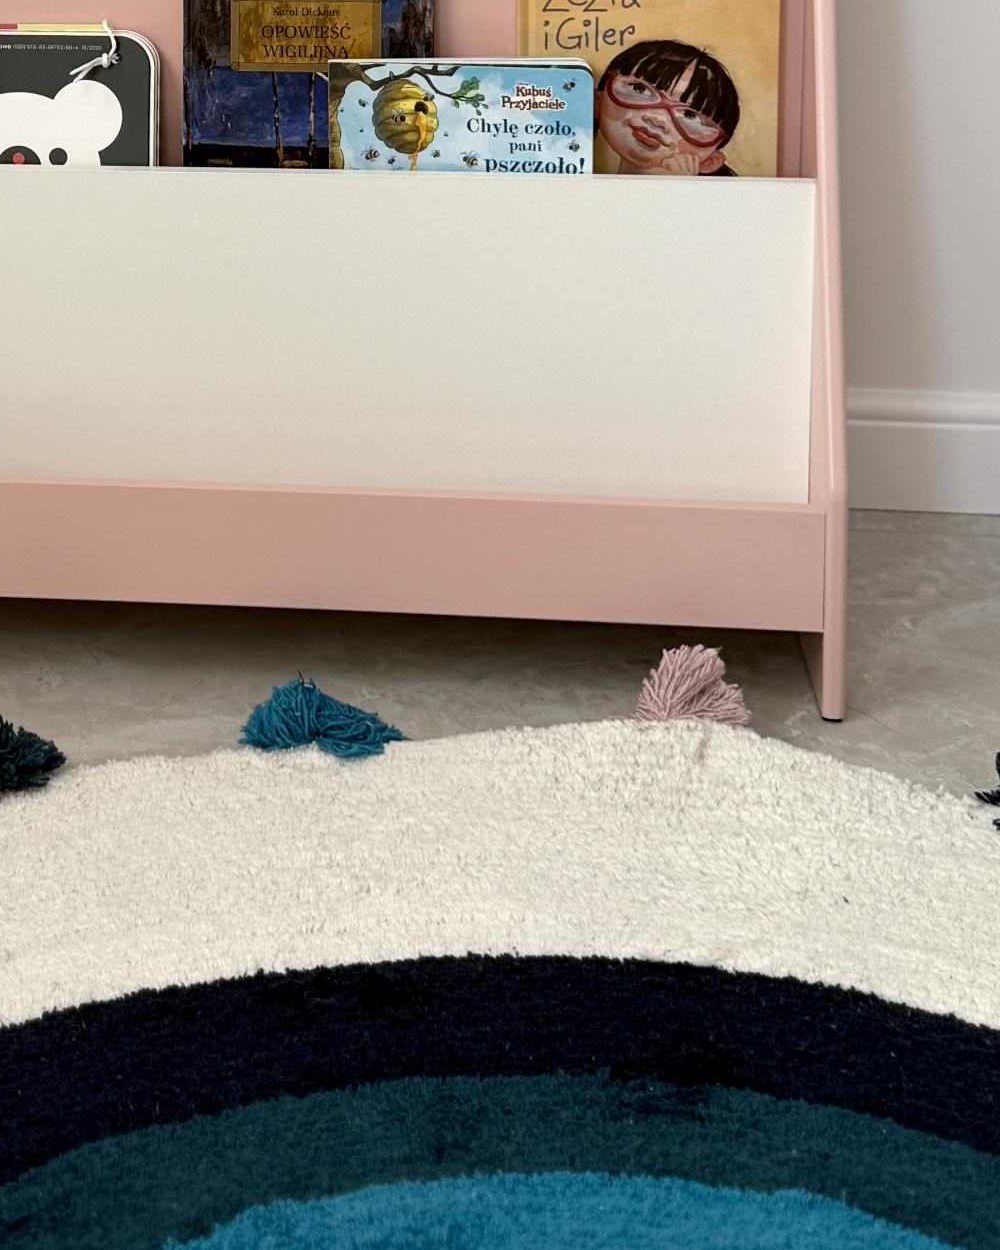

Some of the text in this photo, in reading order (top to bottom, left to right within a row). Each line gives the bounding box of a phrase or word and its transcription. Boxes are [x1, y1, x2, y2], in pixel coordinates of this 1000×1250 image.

[272, 7, 340, 17] Karol Dickens
[261, 23, 351, 39] OPOWIEŚĆ
[543, 16, 636, 52] i Giler
[263, 45, 349, 61] WIGILIJNA
[515, 85, 552, 97] Kubuś
[501, 95, 566, 110] Przyjaciele
[467, 118, 576, 137] Chylę czoło,
[509, 140, 542, 154] pani
[483, 157, 585, 174] pszczoło!
